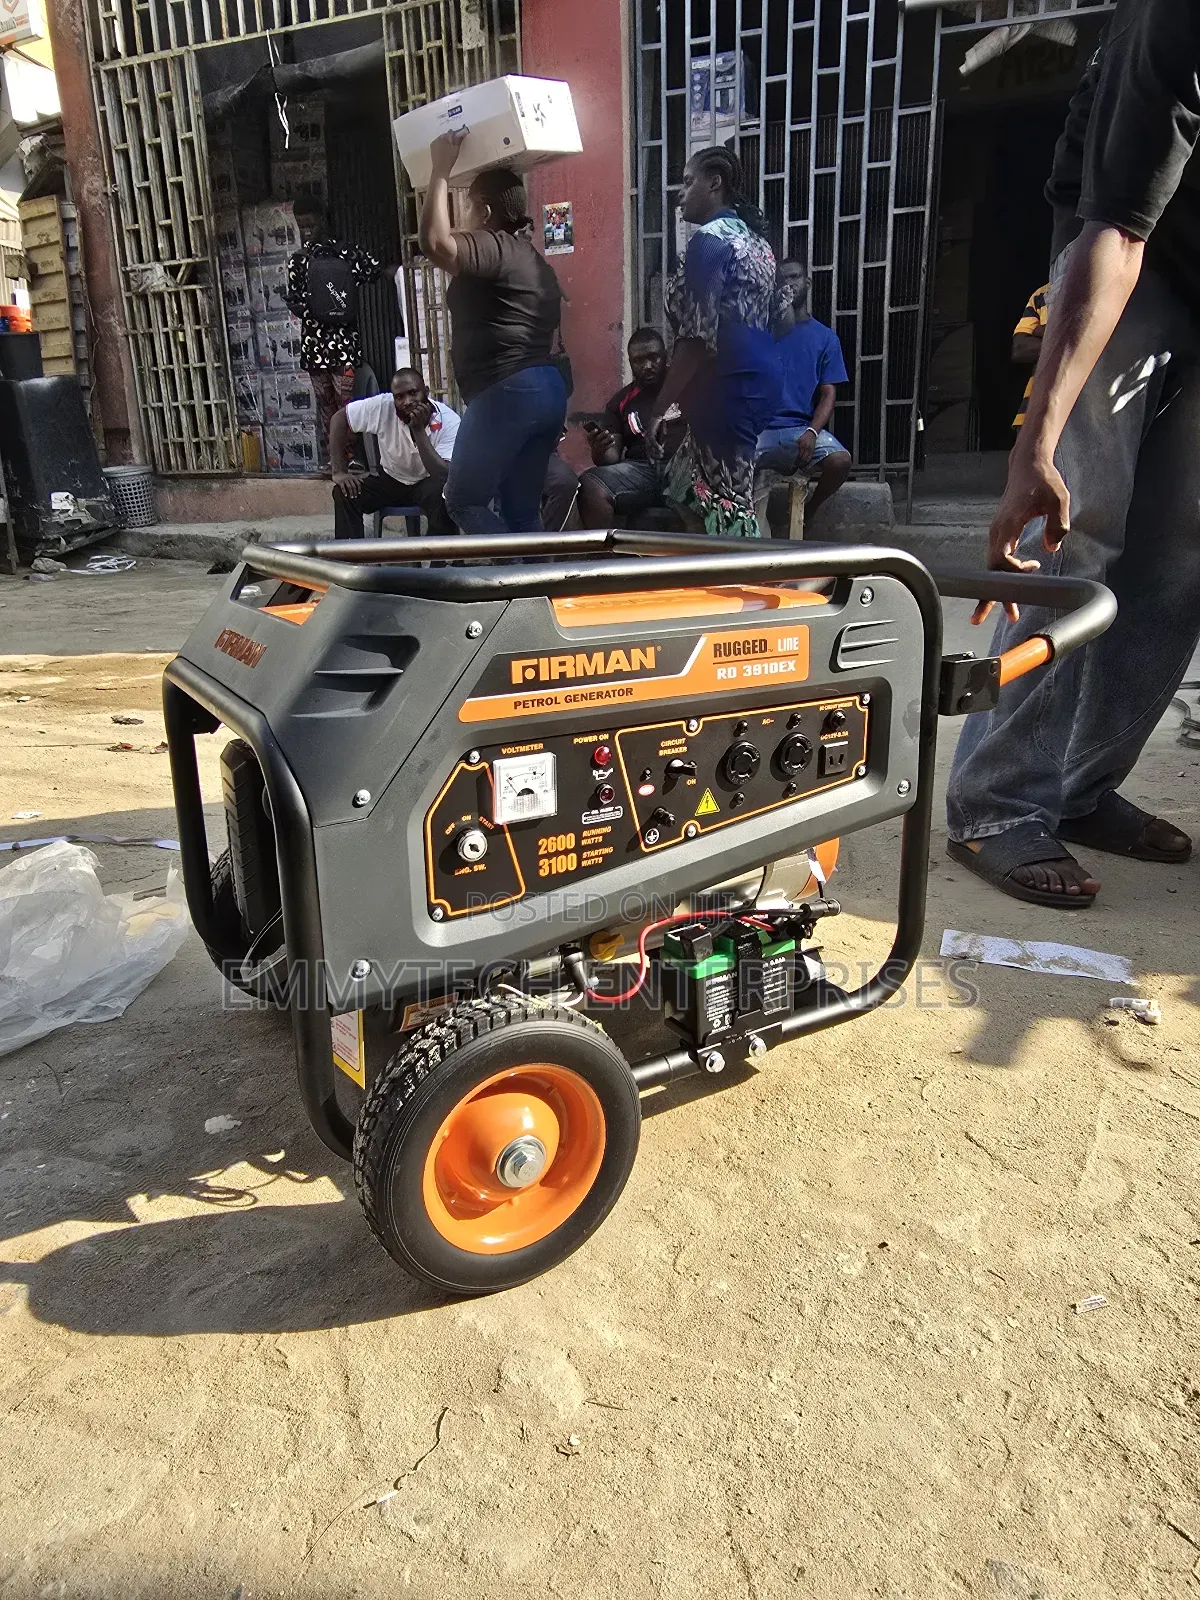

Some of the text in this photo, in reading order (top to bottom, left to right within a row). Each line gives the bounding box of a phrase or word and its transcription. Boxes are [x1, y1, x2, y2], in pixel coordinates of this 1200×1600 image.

[326, 281, 347, 308] Supreme
[713, 637, 799, 658] RUGGED LINE
[511, 646, 656, 684] FIRMAN
[717, 660, 796, 680] RD 3910EX
[513, 687, 634, 710] PETROL GENERATOR
[573, 733, 609, 745] POWER ON
[661, 738, 686, 747] CIRCUIT
[501, 743, 544, 755] VOLTMETER
[659, 746, 687, 756] BREAKER
[686, 778, 697, 786] ON
[478, 816, 495, 830] START
[582, 826, 612, 838] RUNNING
[538, 833, 576, 855] 2600
[581, 836, 604, 846] WATTS
[582, 847, 614, 859] STARTING
[539, 853, 577, 877] 3100
[581, 857, 604, 867] WATTS
